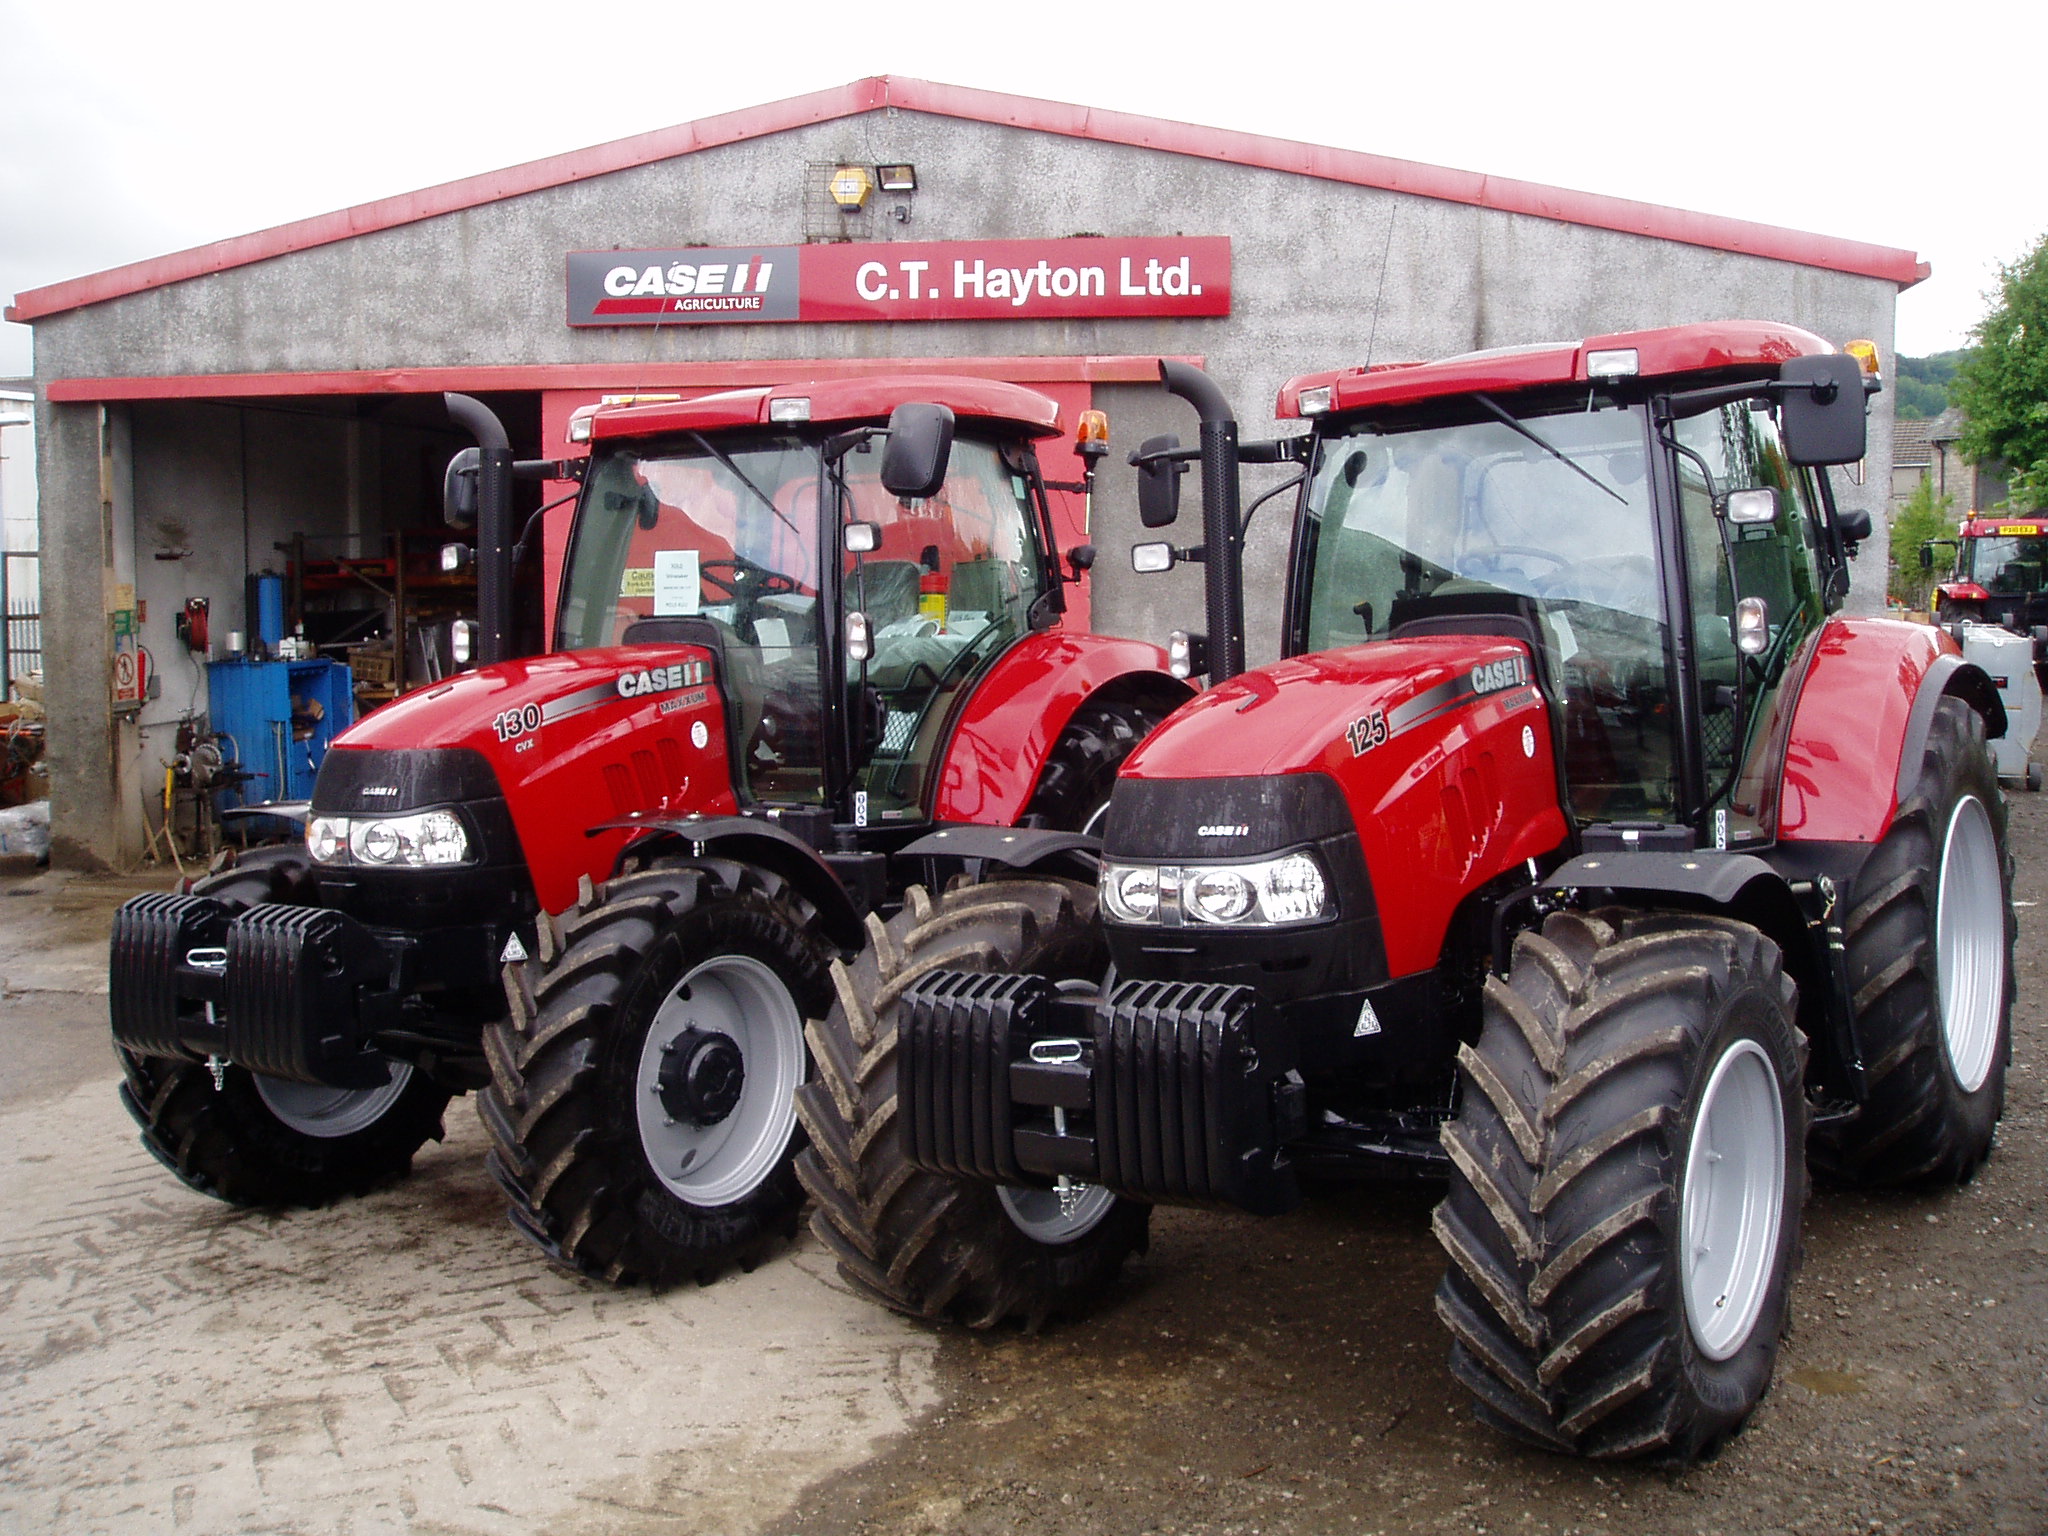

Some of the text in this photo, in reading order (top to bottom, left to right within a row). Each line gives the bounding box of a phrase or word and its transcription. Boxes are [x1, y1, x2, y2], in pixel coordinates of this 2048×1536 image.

[603, 263, 726, 297] CASE
[855, 256, 1203, 306] C.T. Hayton Ltd.
[674, 297, 760, 311] AGRICULTURE
[618, 664, 682, 698] CASE
[1471, 658, 1515, 694] CASE
[493, 703, 541, 743] 130
[1347, 708, 1388, 758] 125
[515, 738, 534, 753] CVX
[362, 787, 388, 796] CASE
[1198, 825, 1235, 836] CASE
